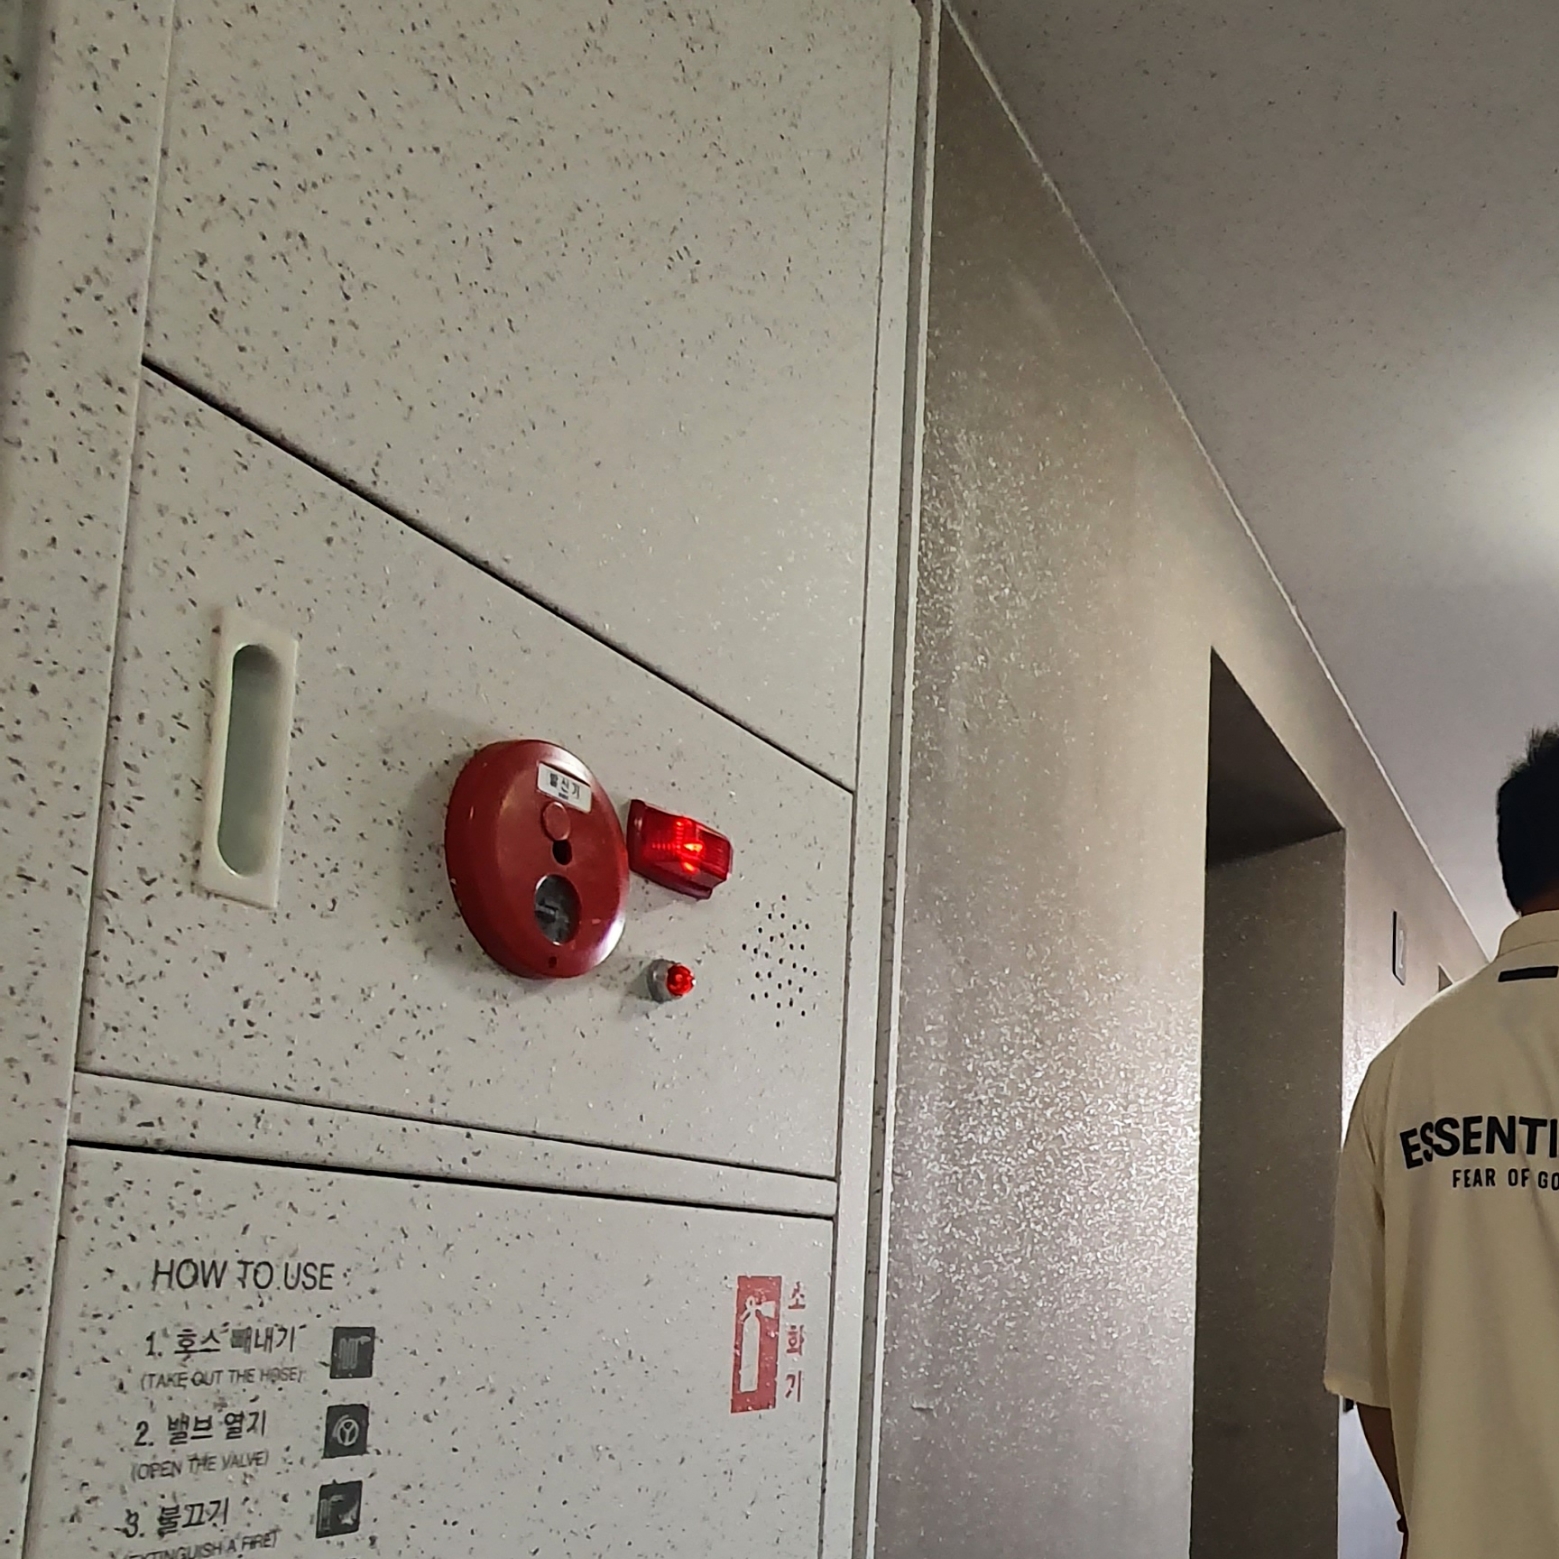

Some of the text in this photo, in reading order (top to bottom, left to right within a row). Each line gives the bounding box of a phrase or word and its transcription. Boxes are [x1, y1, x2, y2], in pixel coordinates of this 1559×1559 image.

[1452, 1168, 1496, 1188] FEAR
[1508, 1168, 1530, 1188] OF
[152, 1259, 335, 1291] HOW TO USE
[145, 1331, 163, 1357] 1.
[174, 1328, 221, 1356] 호스
[785, 1281, 806, 1403] 소화기
[191, 1370, 223, 1387] OUT
[229, 1369, 256, 1384] THE
[134, 1410, 266, 1447] 2. 밸브 열기
[131, 1450, 269, 1482] (OPEN THE VALVE)
[122, 1497, 229, 1538] 3. 불끄기
[226, 1538, 237, 1553] A
